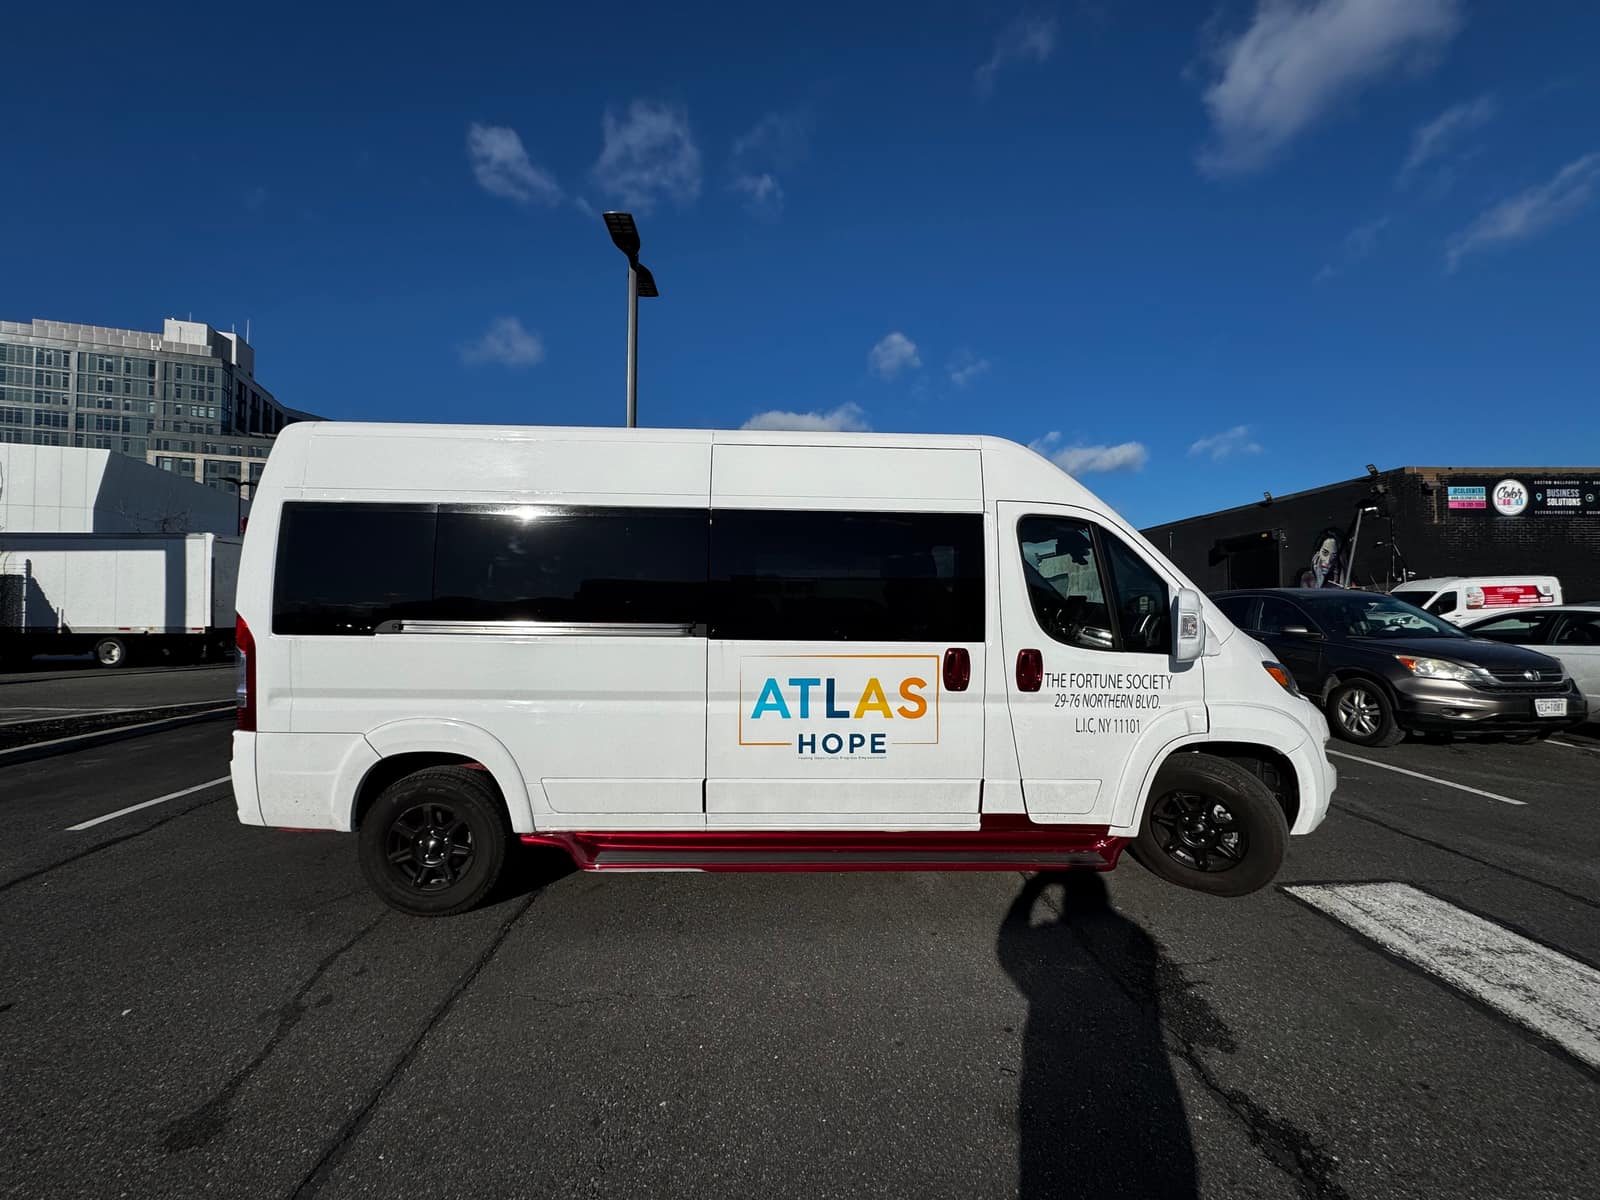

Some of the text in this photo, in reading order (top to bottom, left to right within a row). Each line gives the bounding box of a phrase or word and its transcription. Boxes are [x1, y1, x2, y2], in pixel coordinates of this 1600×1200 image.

[1497, 486, 1523, 500] Color
[1546, 488, 1580, 497] BUSINESS
[1546, 497, 1582, 506] SOLUTIONS
[1045, 672, 1173, 690] THE FORTUNE SOCIETY
[751, 677, 928, 720] ATLAS
[1054, 693, 1161, 709] 29-76 NORTHERN BLVD.
[1098, 718, 1112, 734] NY
[1114, 719, 1141, 734] 11101
[798, 733, 886, 754] HOPE
